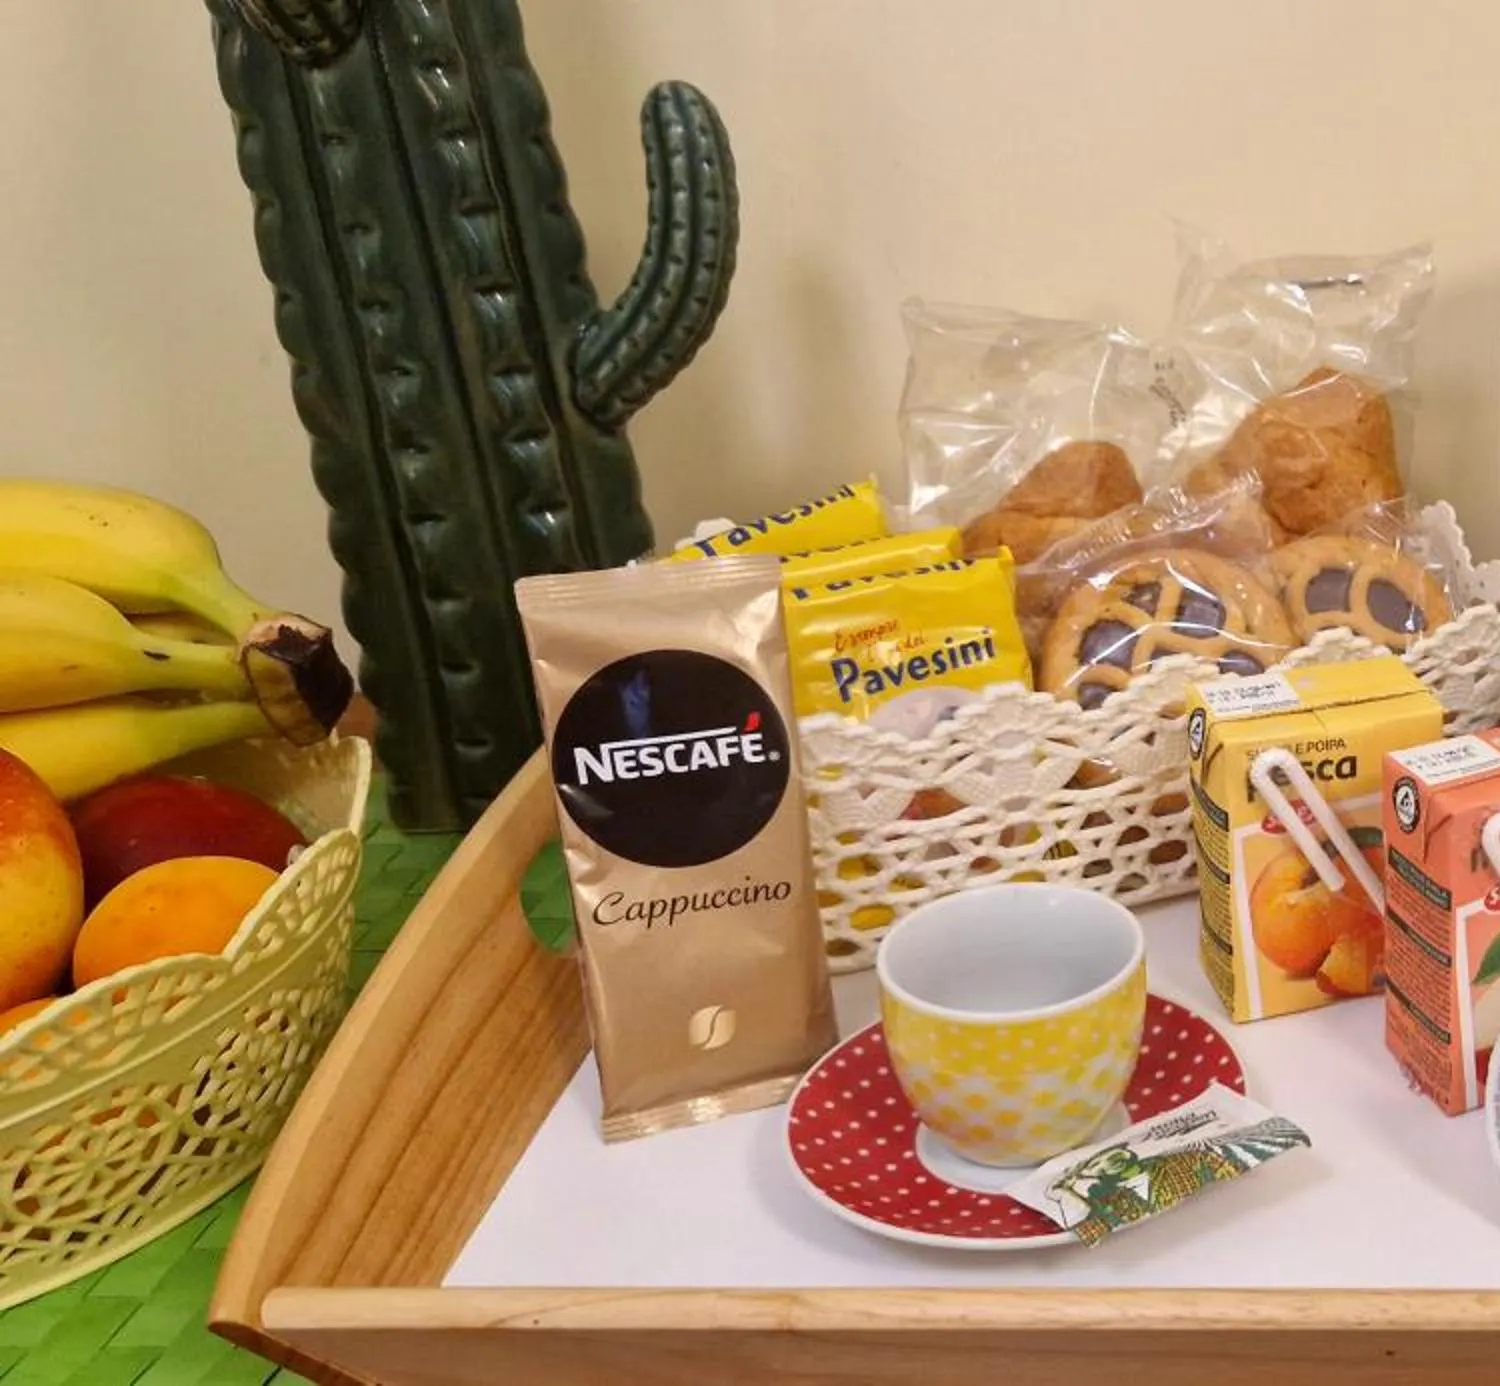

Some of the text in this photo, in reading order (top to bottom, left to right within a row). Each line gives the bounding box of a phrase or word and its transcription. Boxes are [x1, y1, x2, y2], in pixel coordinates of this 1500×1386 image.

[831, 625, 996, 704] Pavesini
[573, 712, 767, 786] NESCAFÉ
[593, 875, 792, 929] Cappuccino
